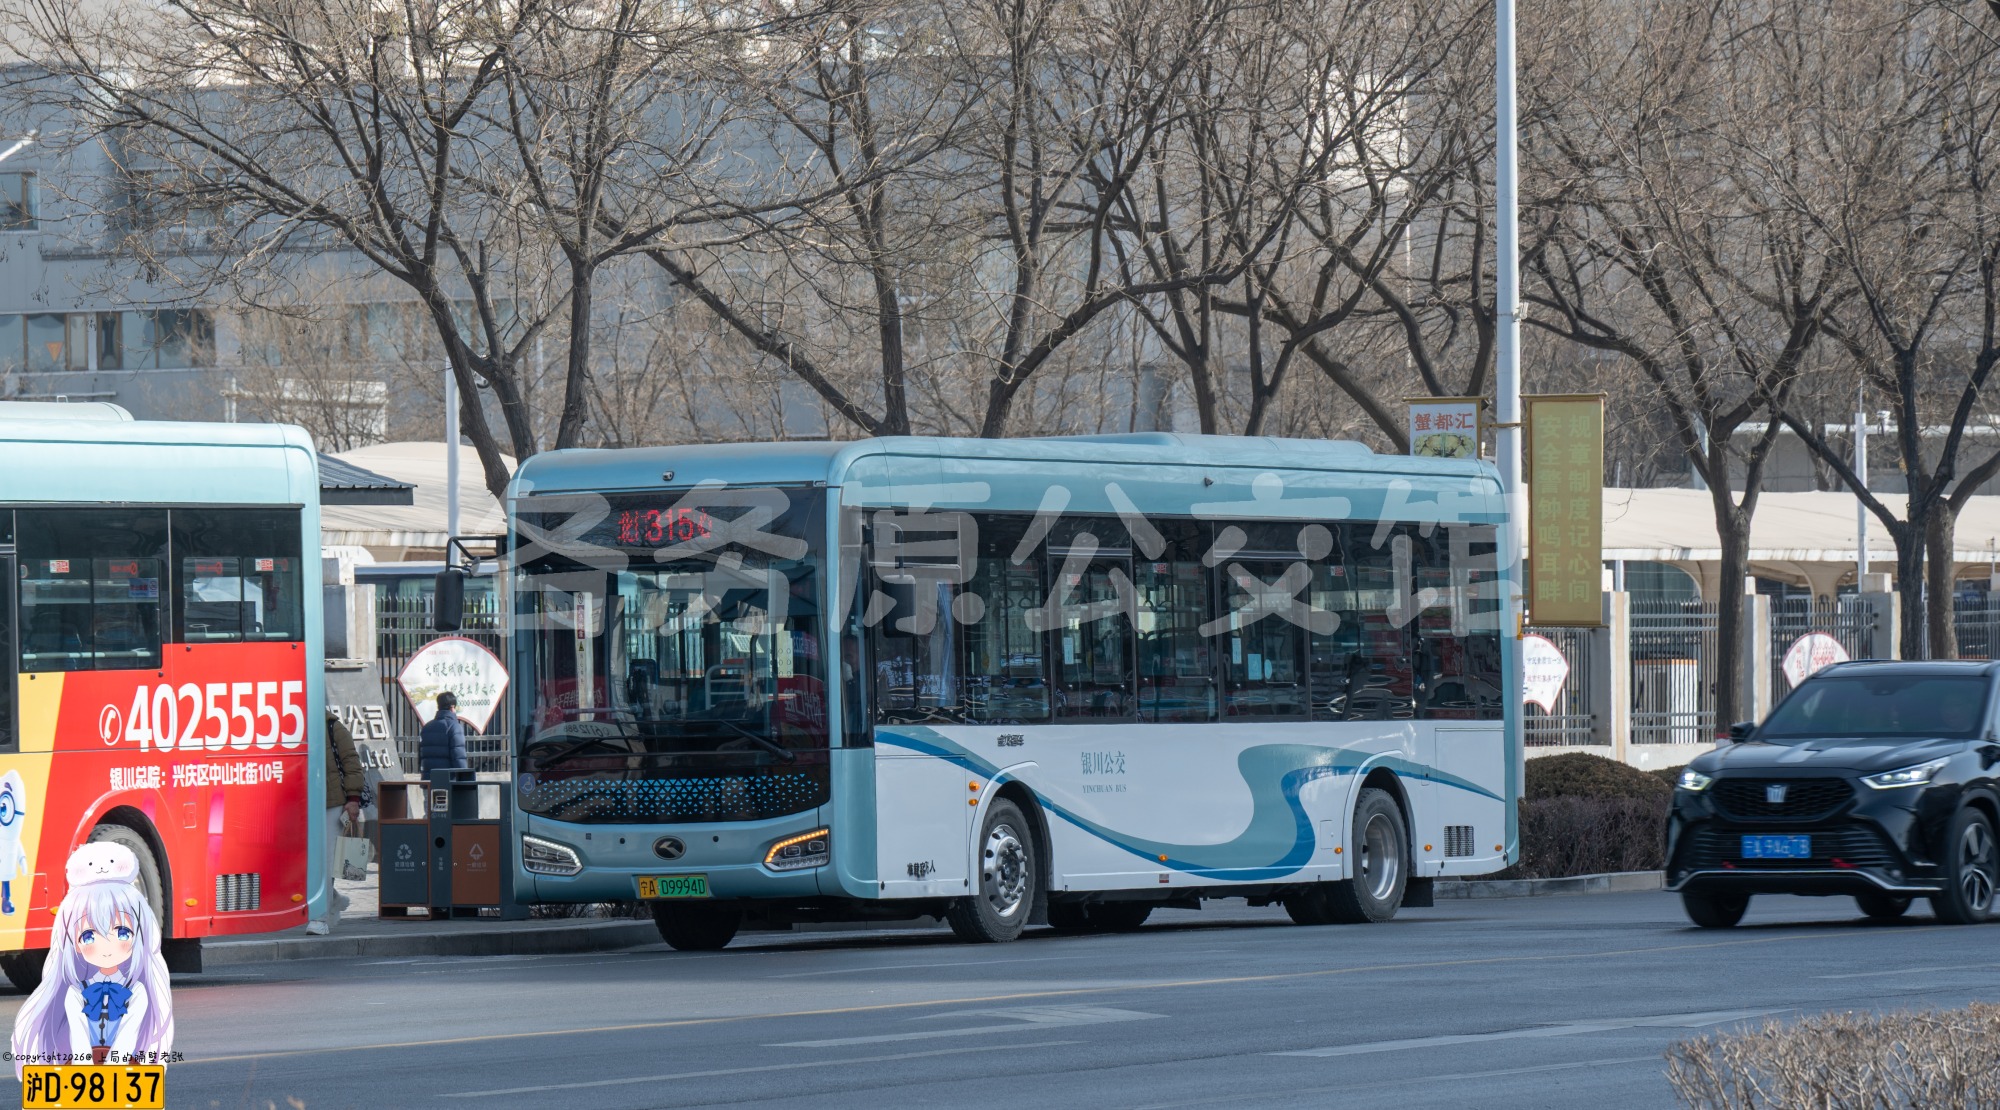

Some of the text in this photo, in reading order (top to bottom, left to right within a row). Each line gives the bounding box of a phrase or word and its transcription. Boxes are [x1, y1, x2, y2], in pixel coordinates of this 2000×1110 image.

[1415, 412, 1475, 431] 蟹都汇
[1538, 415, 1562, 602] 安全警钟鸣耳畔
[1568, 415, 1592, 603] 规章制度记心间
[125, 681, 305, 752] 4025555
[1081, 750, 1126, 775] 银川公交
[1082, 784, 1127, 794] YINCHUAN BUS
